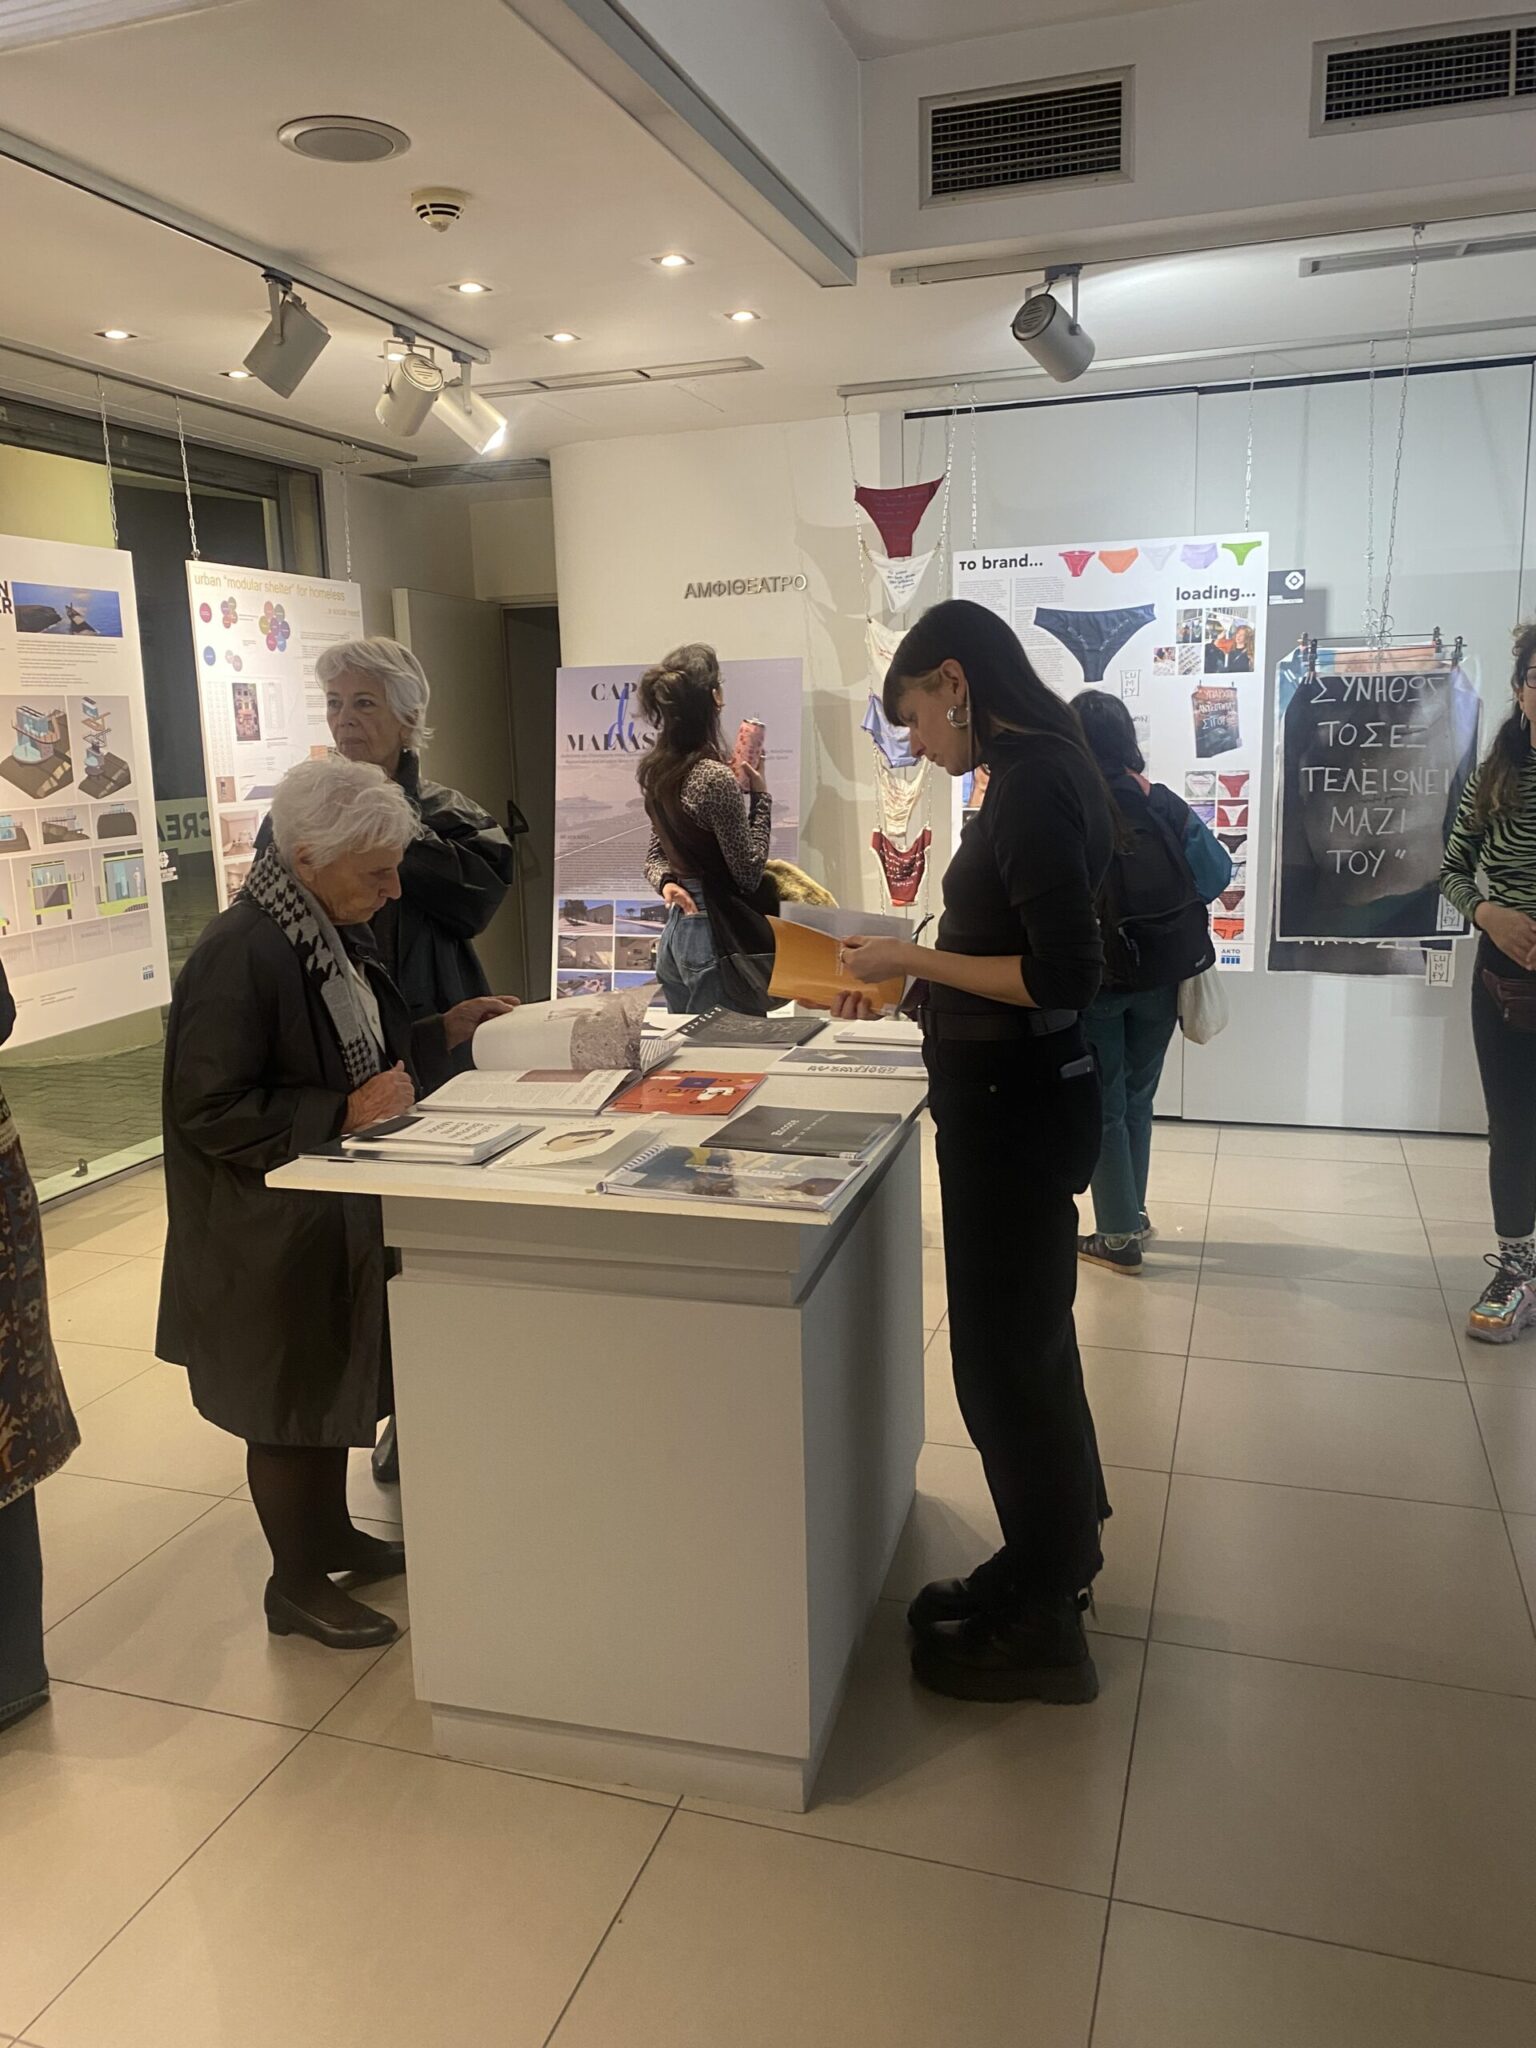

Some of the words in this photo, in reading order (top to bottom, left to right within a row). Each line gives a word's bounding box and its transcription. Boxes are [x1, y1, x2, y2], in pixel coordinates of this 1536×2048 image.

[982, 553, 1043, 570] brand...
[194, 573, 222, 586] urban
[297, 585, 308, 597] for
[309, 587, 345, 601] homeless
[684, 574, 807, 600] ΑΜΦΙΘΕΑΤΡΟ
[1176, 585, 1257, 601] loading...
[1330, 806, 1407, 836] ΜΑΖΙ
